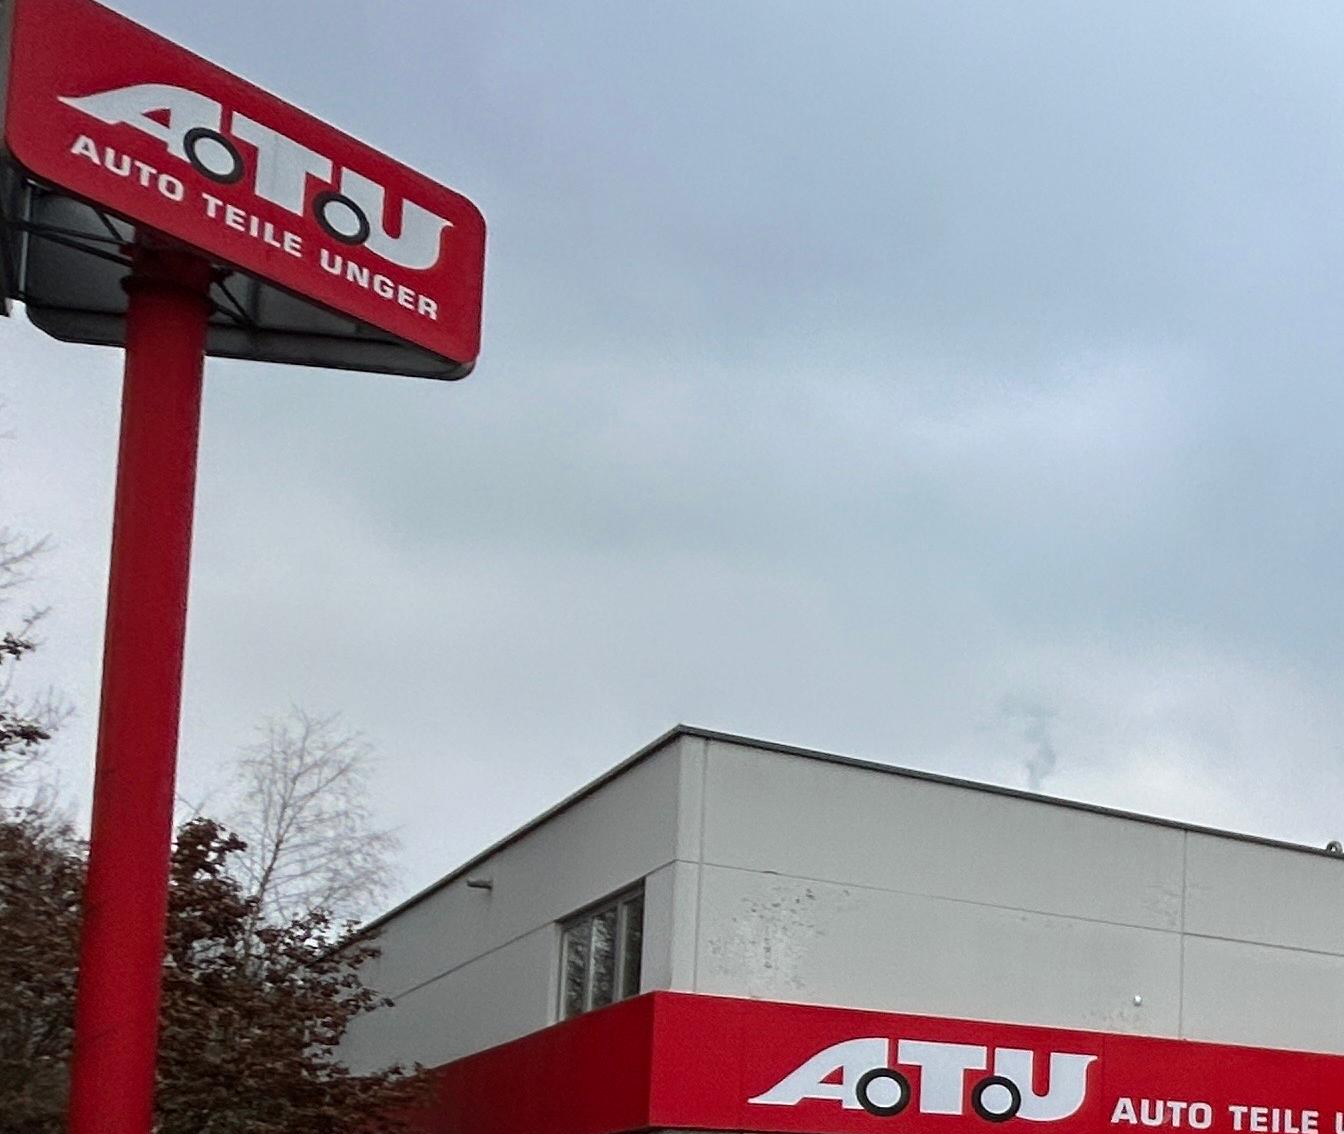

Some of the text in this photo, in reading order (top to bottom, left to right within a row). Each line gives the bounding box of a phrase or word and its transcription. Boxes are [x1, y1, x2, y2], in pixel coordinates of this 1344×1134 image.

[57, 83, 455, 270] ATU
[71, 135, 439, 321] AUTO TEILE UNGER
[748, 1037, 1098, 1122] ATU
[1110, 1097, 1213, 1129] AUTO
